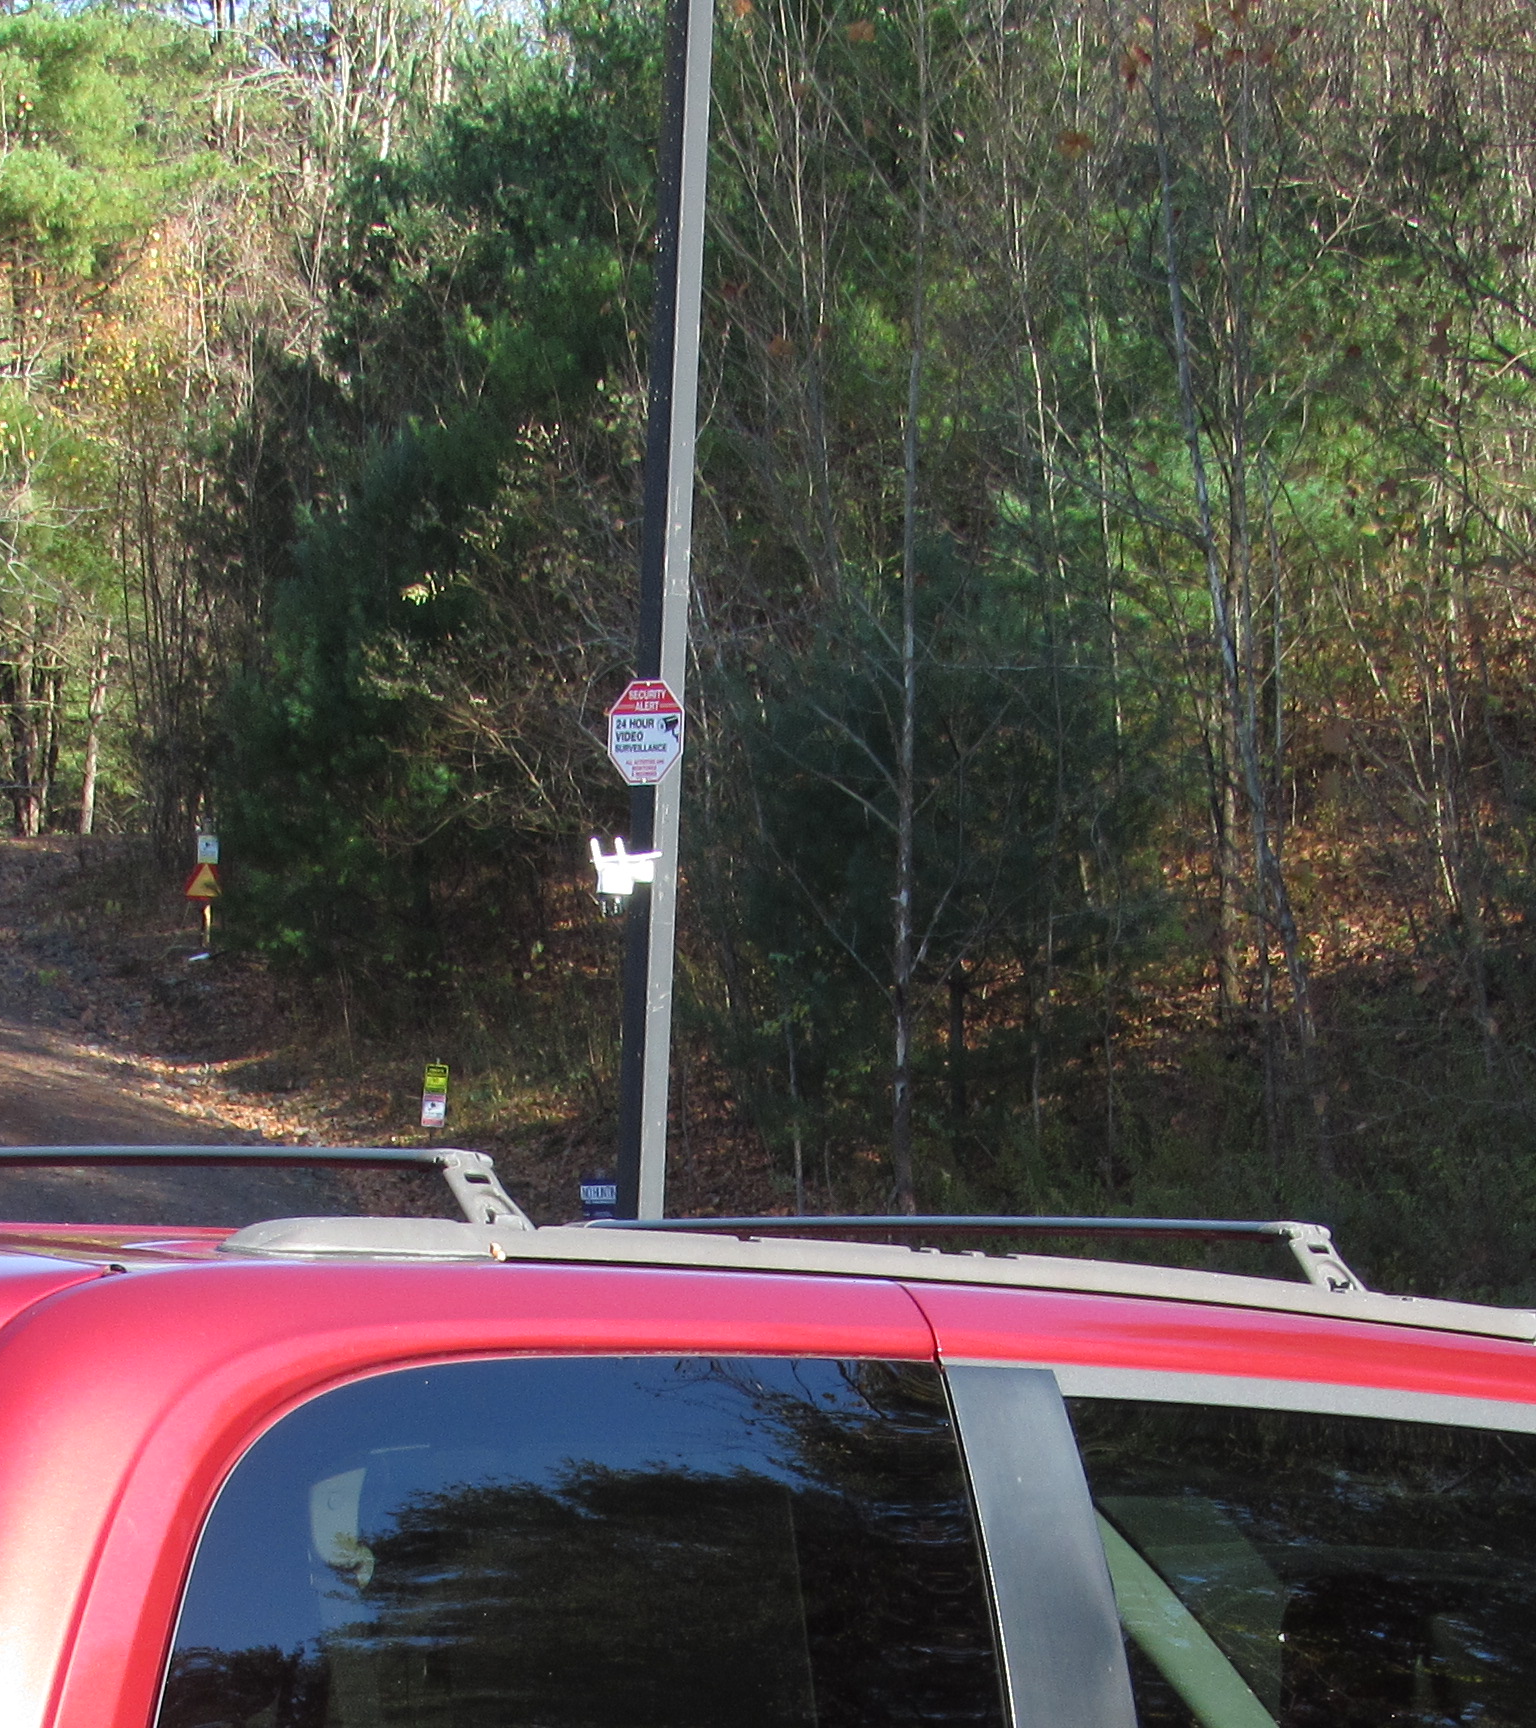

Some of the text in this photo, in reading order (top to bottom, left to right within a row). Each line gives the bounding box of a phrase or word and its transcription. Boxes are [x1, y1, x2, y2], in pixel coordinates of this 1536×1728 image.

[629, 689, 666, 700] SECURITY
[635, 701, 659, 711] ALERT
[616, 718, 654, 729] 24 HOUR
[616, 731, 644, 742] VIDEO
